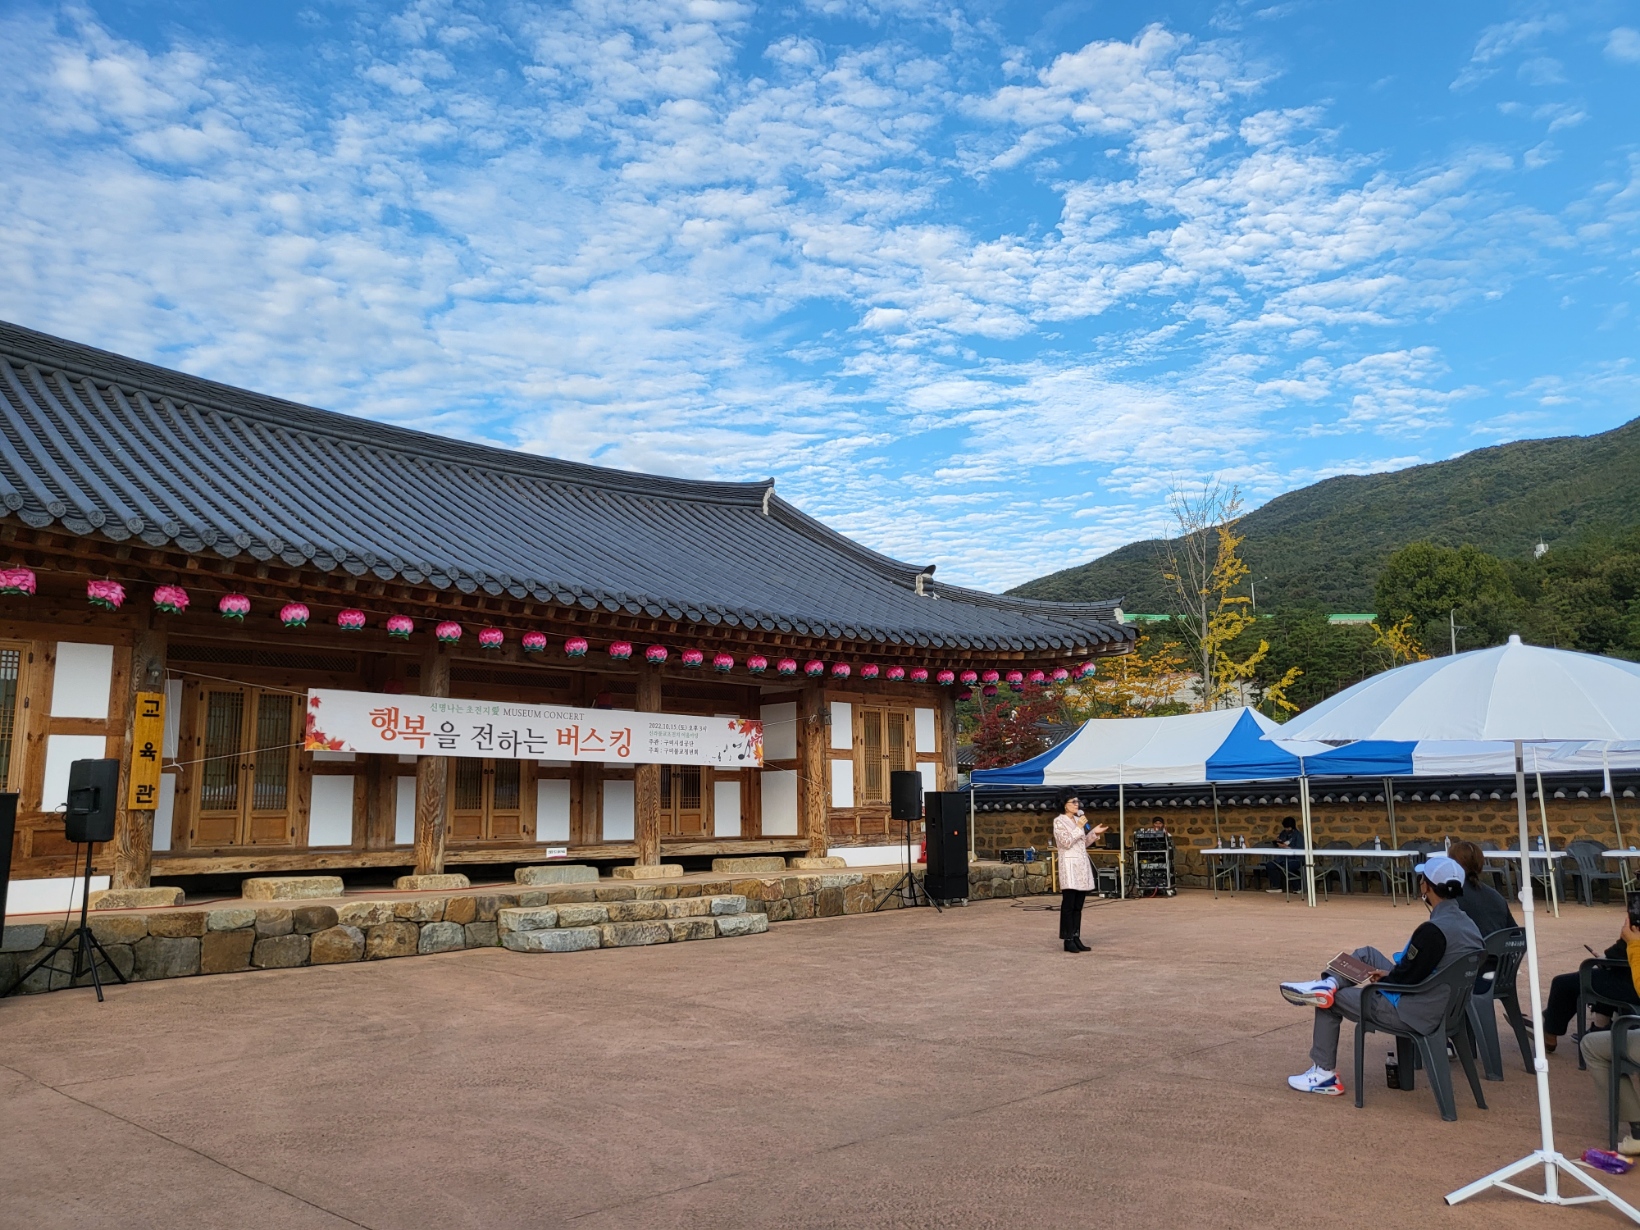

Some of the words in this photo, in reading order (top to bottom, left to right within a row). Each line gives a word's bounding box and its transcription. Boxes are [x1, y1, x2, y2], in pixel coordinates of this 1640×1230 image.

[368, 706, 461, 750] 행복을
[470, 723, 548, 757] 전하는
[555, 724, 632, 758] 버스킹
[430, 702, 464, 714] 신명나는
[503, 708, 541, 719] MUSEUM
[543, 710, 585, 721] CONCERT
[136, 699, 160, 804] 교육관
